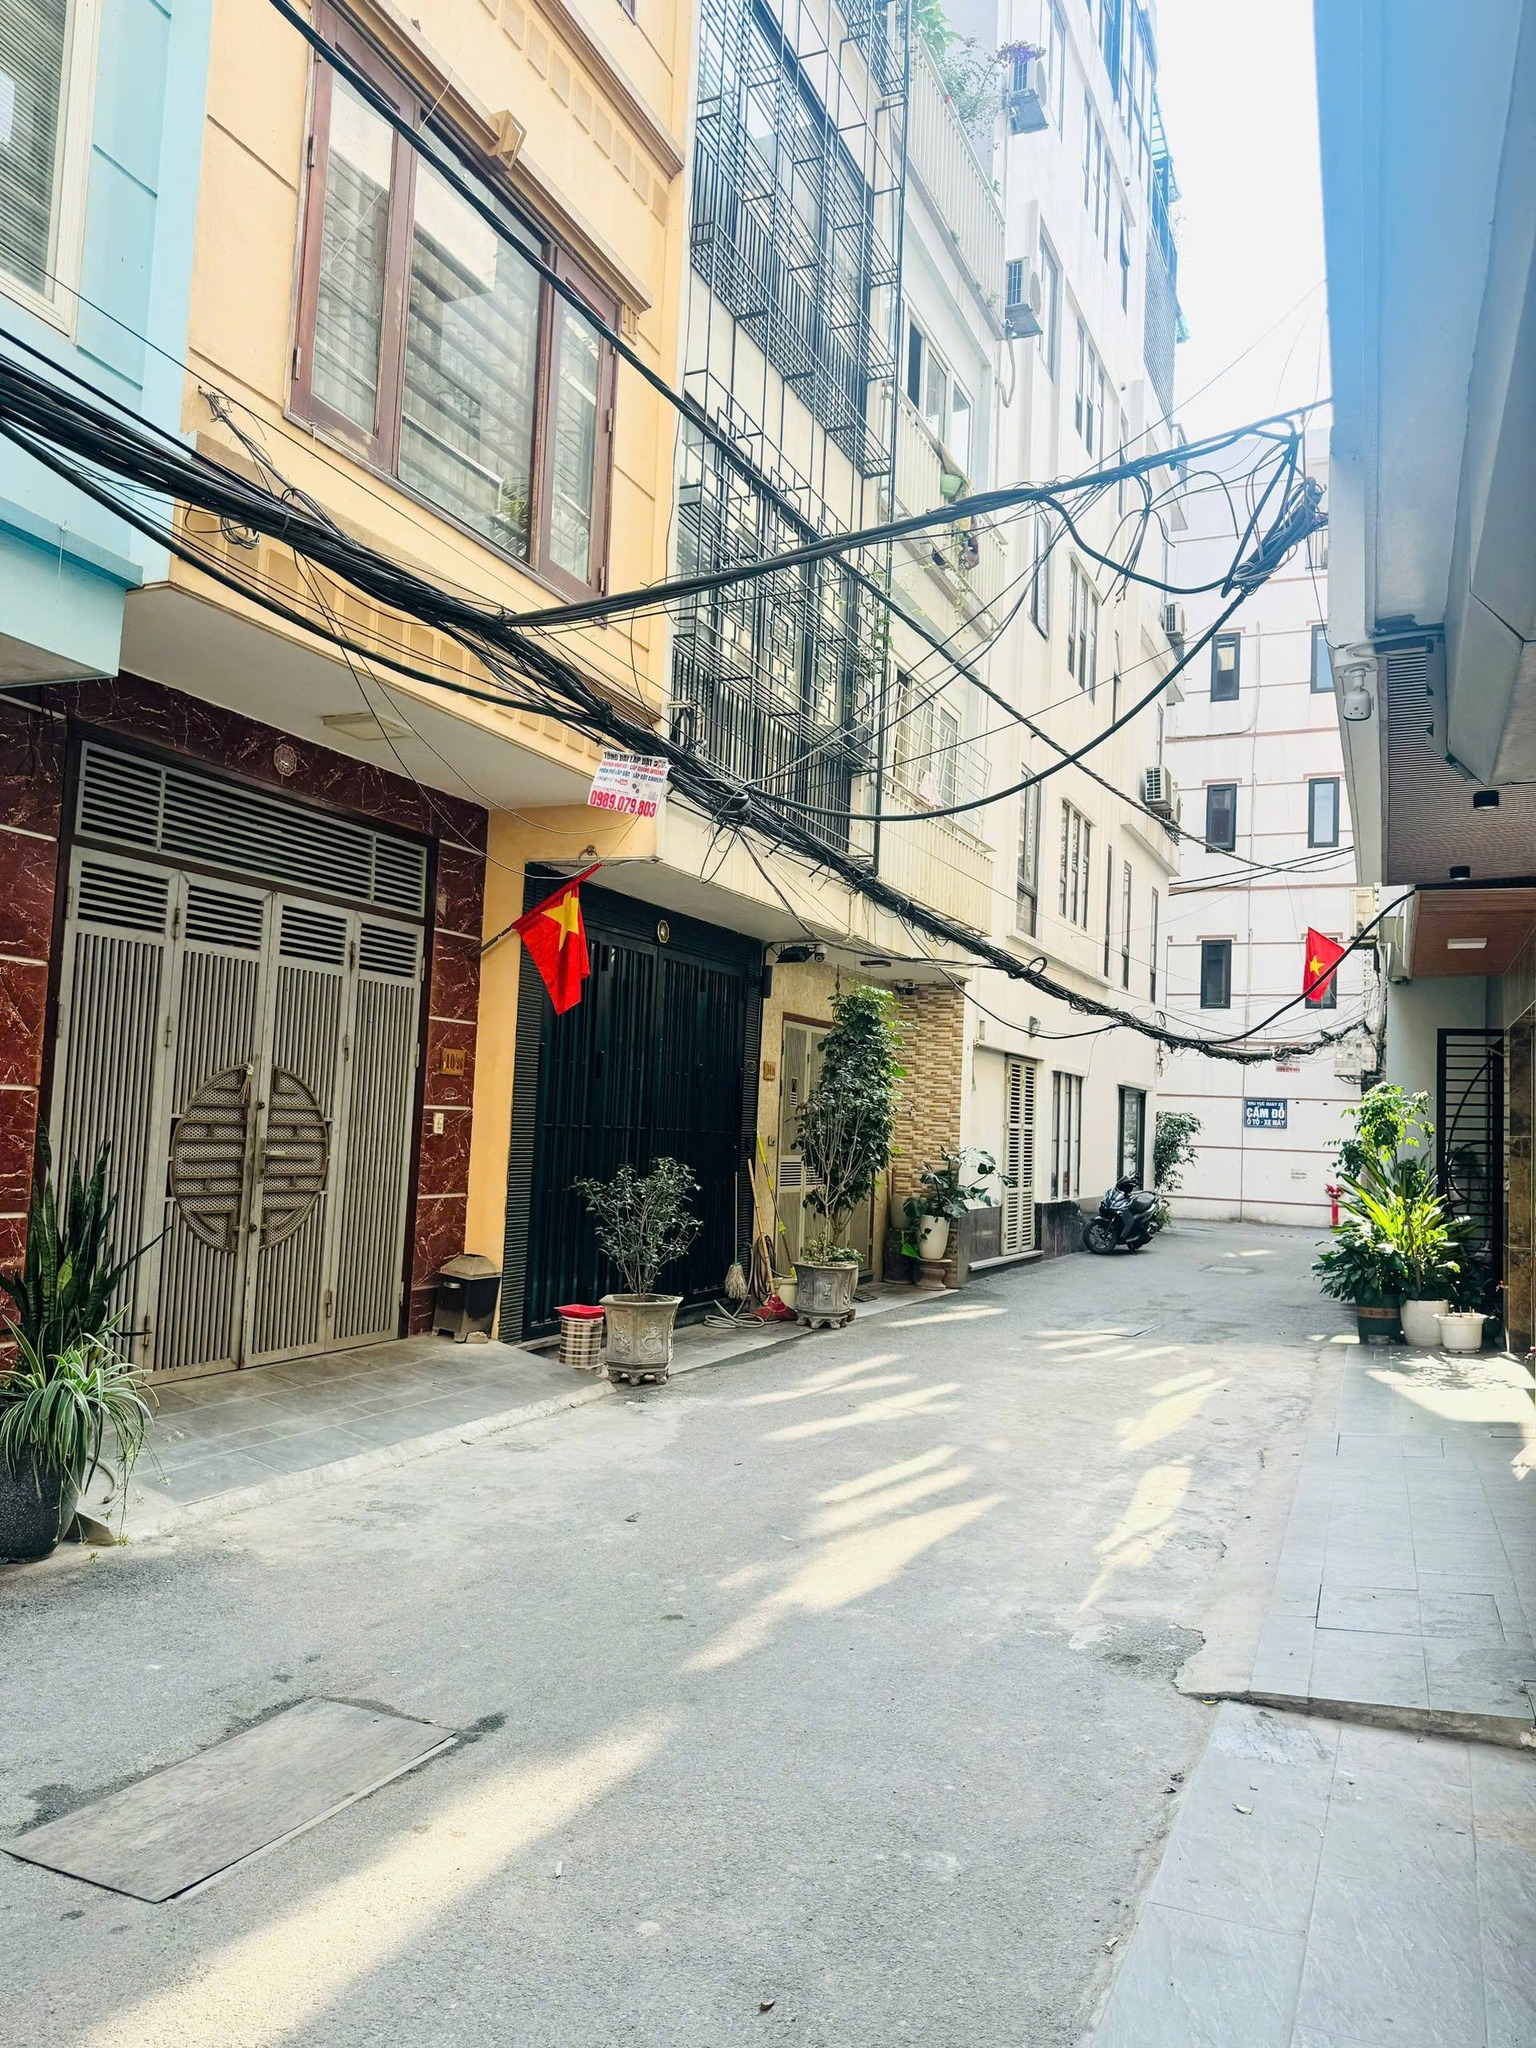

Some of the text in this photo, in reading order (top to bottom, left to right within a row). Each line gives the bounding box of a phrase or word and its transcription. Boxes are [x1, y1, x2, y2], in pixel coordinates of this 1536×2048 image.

[590, 790, 657, 817] 0989.079.803
[1247, 1106, 1269, 1118] CẤM
[1247, 1117, 1251, 1125] Ô
